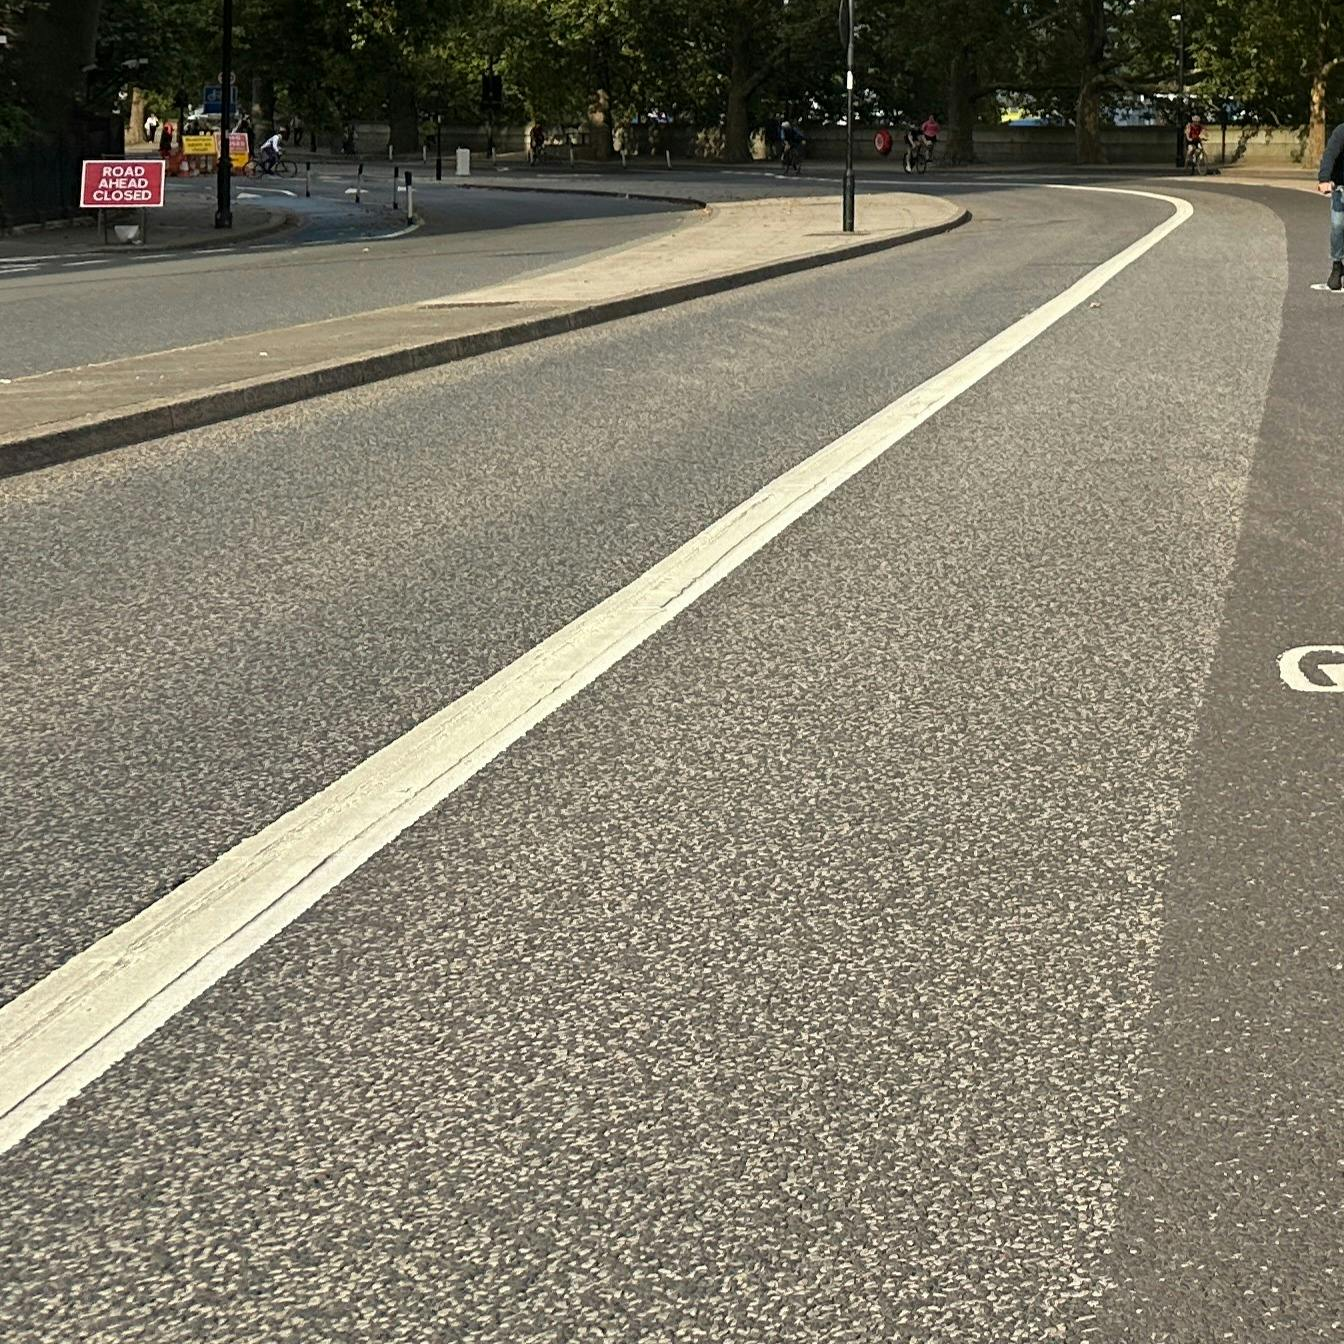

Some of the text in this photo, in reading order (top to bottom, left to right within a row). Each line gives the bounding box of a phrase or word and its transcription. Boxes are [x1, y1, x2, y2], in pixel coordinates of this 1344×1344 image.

[102, 166, 145, 177] ROAD
[98, 178, 148, 189] AHEAD
[92, 190, 152, 201] CLOSED
